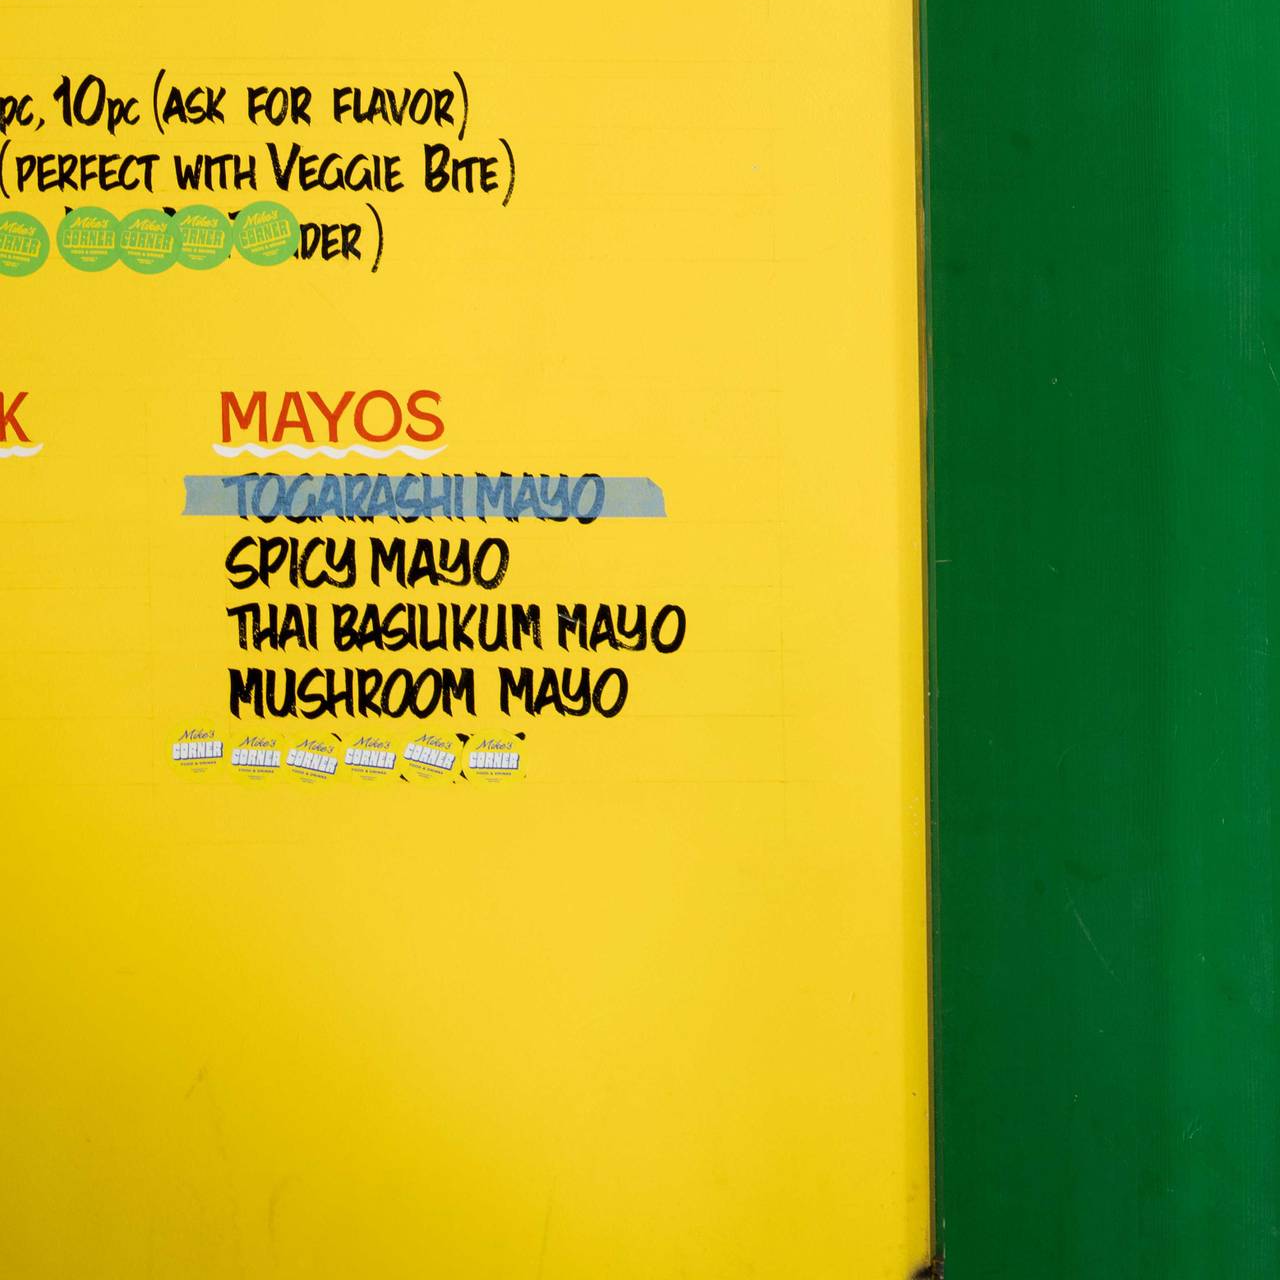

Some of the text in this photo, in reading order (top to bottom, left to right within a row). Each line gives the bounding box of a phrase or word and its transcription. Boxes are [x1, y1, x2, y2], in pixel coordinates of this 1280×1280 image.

[53, 74, 140, 136] 10pc
[154, 69, 226, 134] (ASK
[247, 86, 312, 127] FOR
[334, 72, 469, 141] FLAVOR)
[174, 154, 257, 192] WITH
[63, 229, 116, 249] CORNER
[120, 231, 173, 252] CORNER
[238, 219, 291, 248] CORNER
[222, 390, 445, 443] MAYOS
[222, 471, 606, 524] TOGARASHI MAYO
[226, 536, 510, 590] SPICY MAYO
[226, 603, 687, 654] THAI BASILIKUM MAYO
[229, 667, 629, 720] MUSHROOM MAYO
[172, 741, 224, 760] CORNER
[231, 748, 282, 768] CORNER
[286, 748, 339, 775] CORNER
[344, 747, 397, 770] CORNER
[403, 743, 457, 771] CORNER
[468, 751, 520, 770] CORNER
